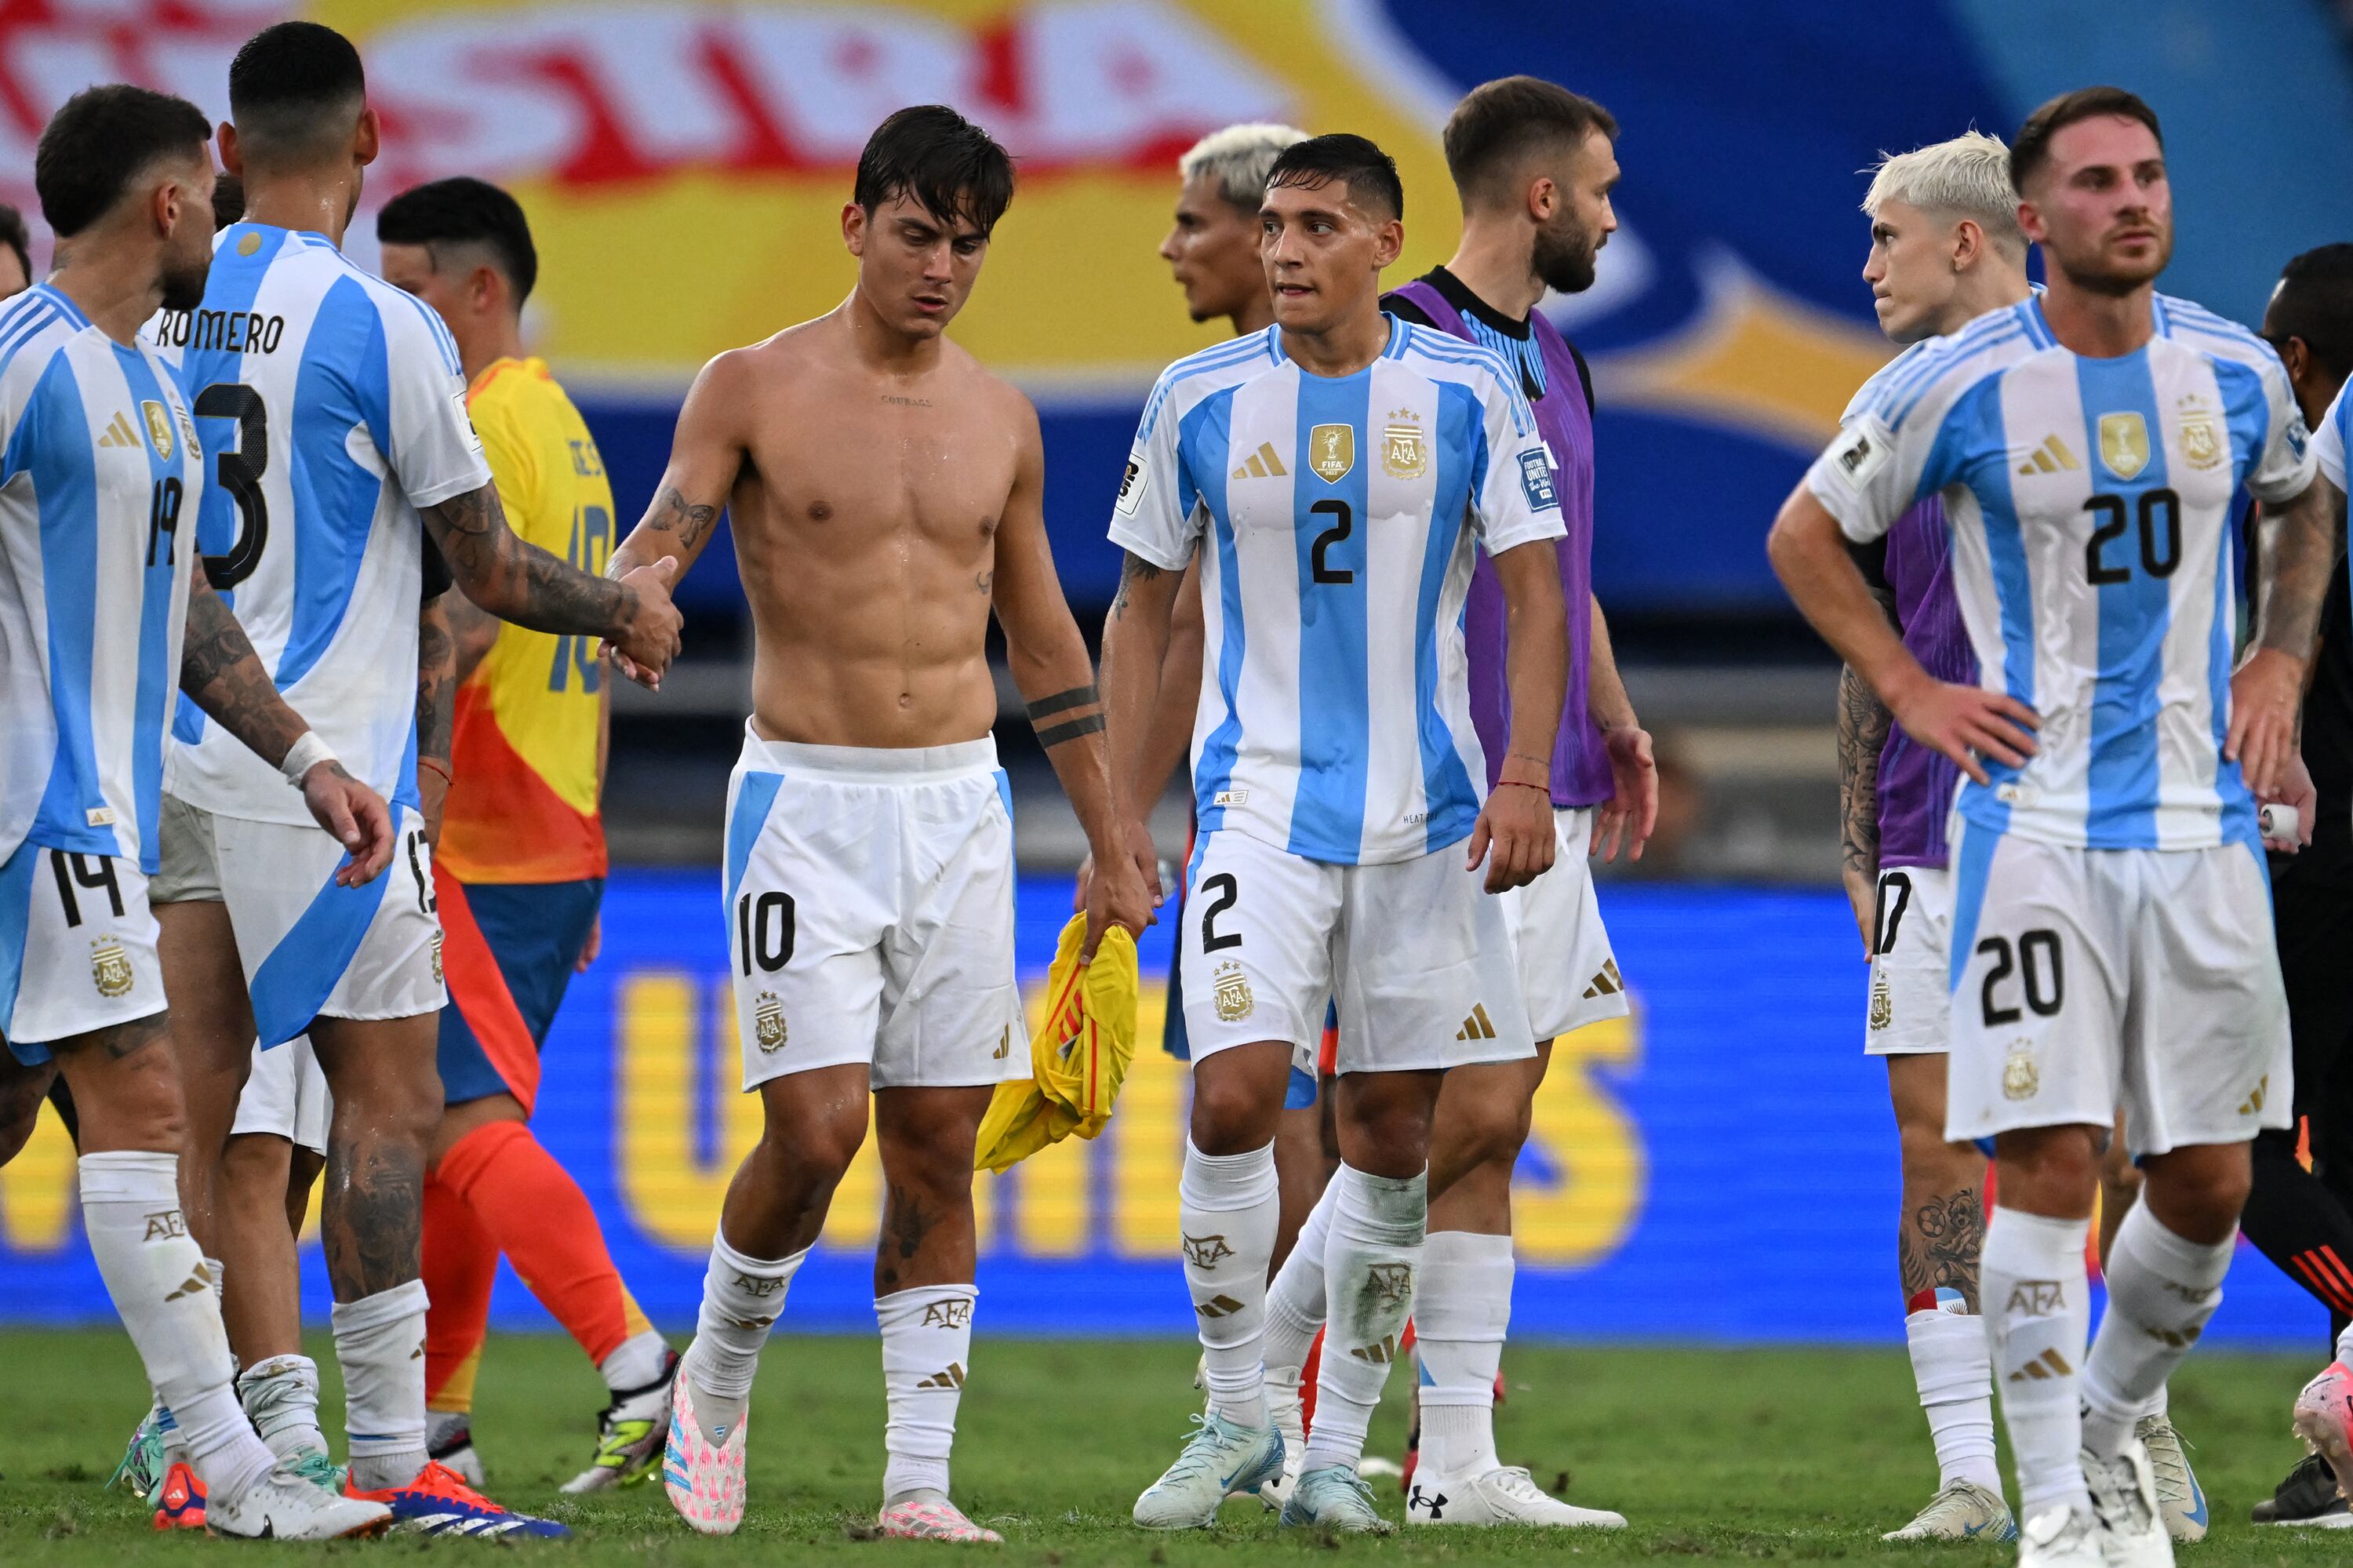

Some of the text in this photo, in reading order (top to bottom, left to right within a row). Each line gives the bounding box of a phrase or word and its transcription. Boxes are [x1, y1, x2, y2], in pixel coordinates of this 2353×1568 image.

[156, 309, 284, 355] ROMERO
[1391, 438, 1418, 464] AFA
[193, 383, 268, 590] 3
[147, 476, 184, 567] 19
[1309, 499, 1353, 584] 2
[2082, 488, 2181, 586] 20
[739, 891, 795, 977] 10
[1201, 872, 1242, 955] 2
[1872, 871, 1912, 955] 17
[103, 959, 126, 982] AFA
[1977, 929, 2065, 1029] 20
[1222, 985, 1246, 1007] AFA
[759, 1015, 780, 1039] AFA
[1181, 1231, 1236, 1270] AFA
[731, 1272, 785, 1297] AFA
[2006, 1280, 2068, 1317] AFA
[919, 1298, 972, 1330] AFA
